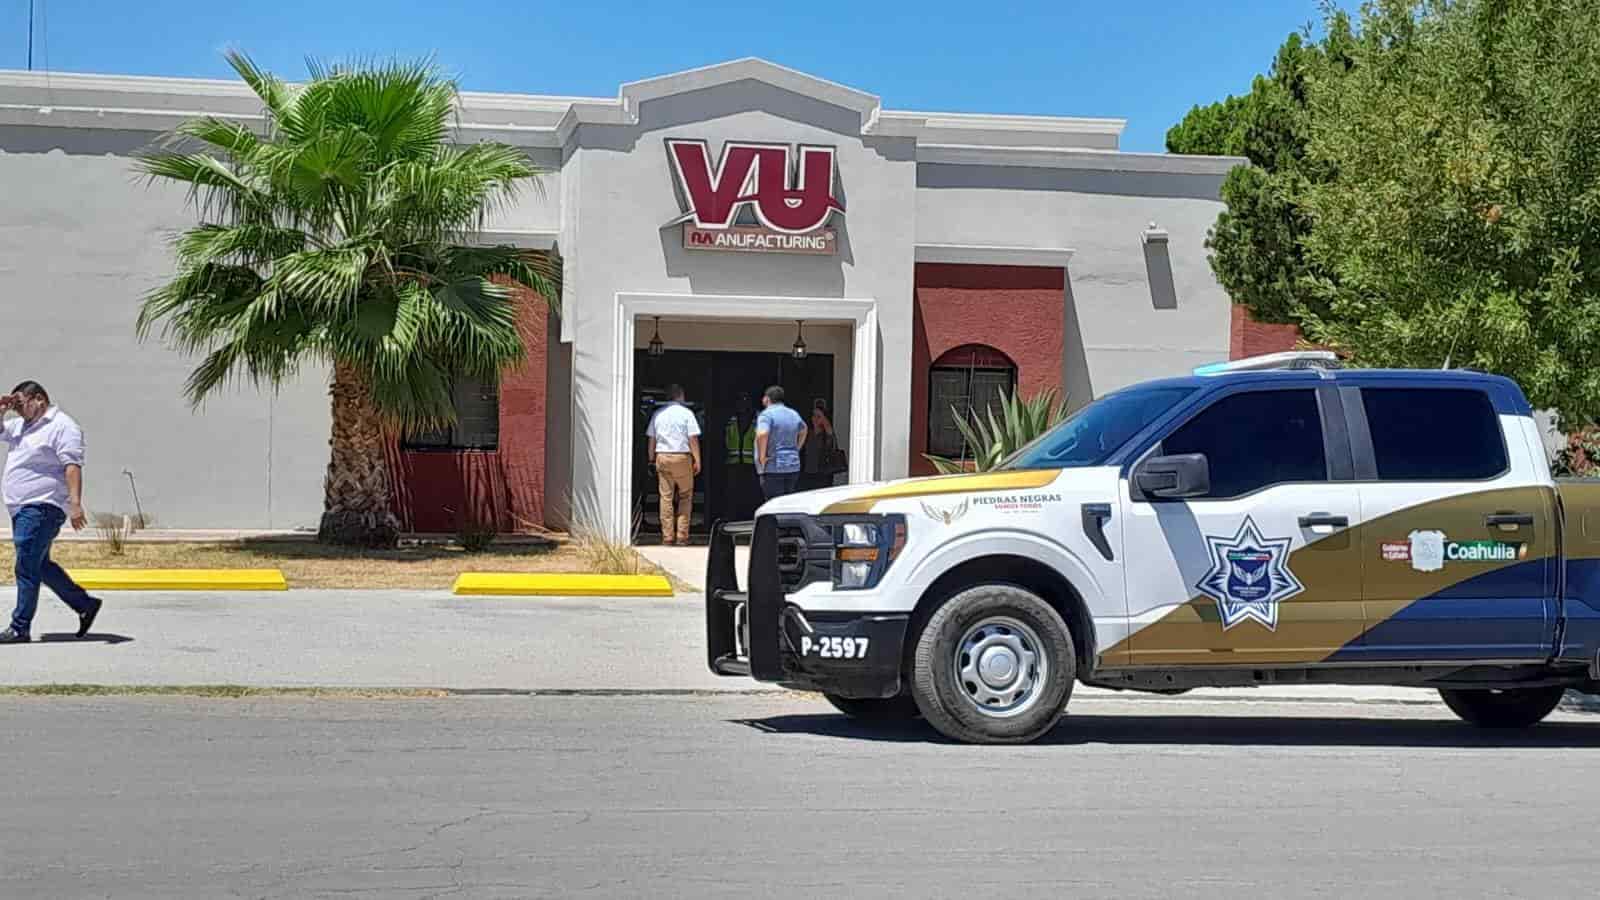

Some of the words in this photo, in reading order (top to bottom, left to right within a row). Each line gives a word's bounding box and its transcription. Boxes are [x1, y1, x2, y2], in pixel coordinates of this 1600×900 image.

[666, 139, 838, 234] VU
[972, 495, 1017, 505] PIEDRAS
[1020, 493, 1062, 504] NEGRAS
[1447, 542, 1516, 560] Coahuila
[801, 636, 869, 658] P-2597
